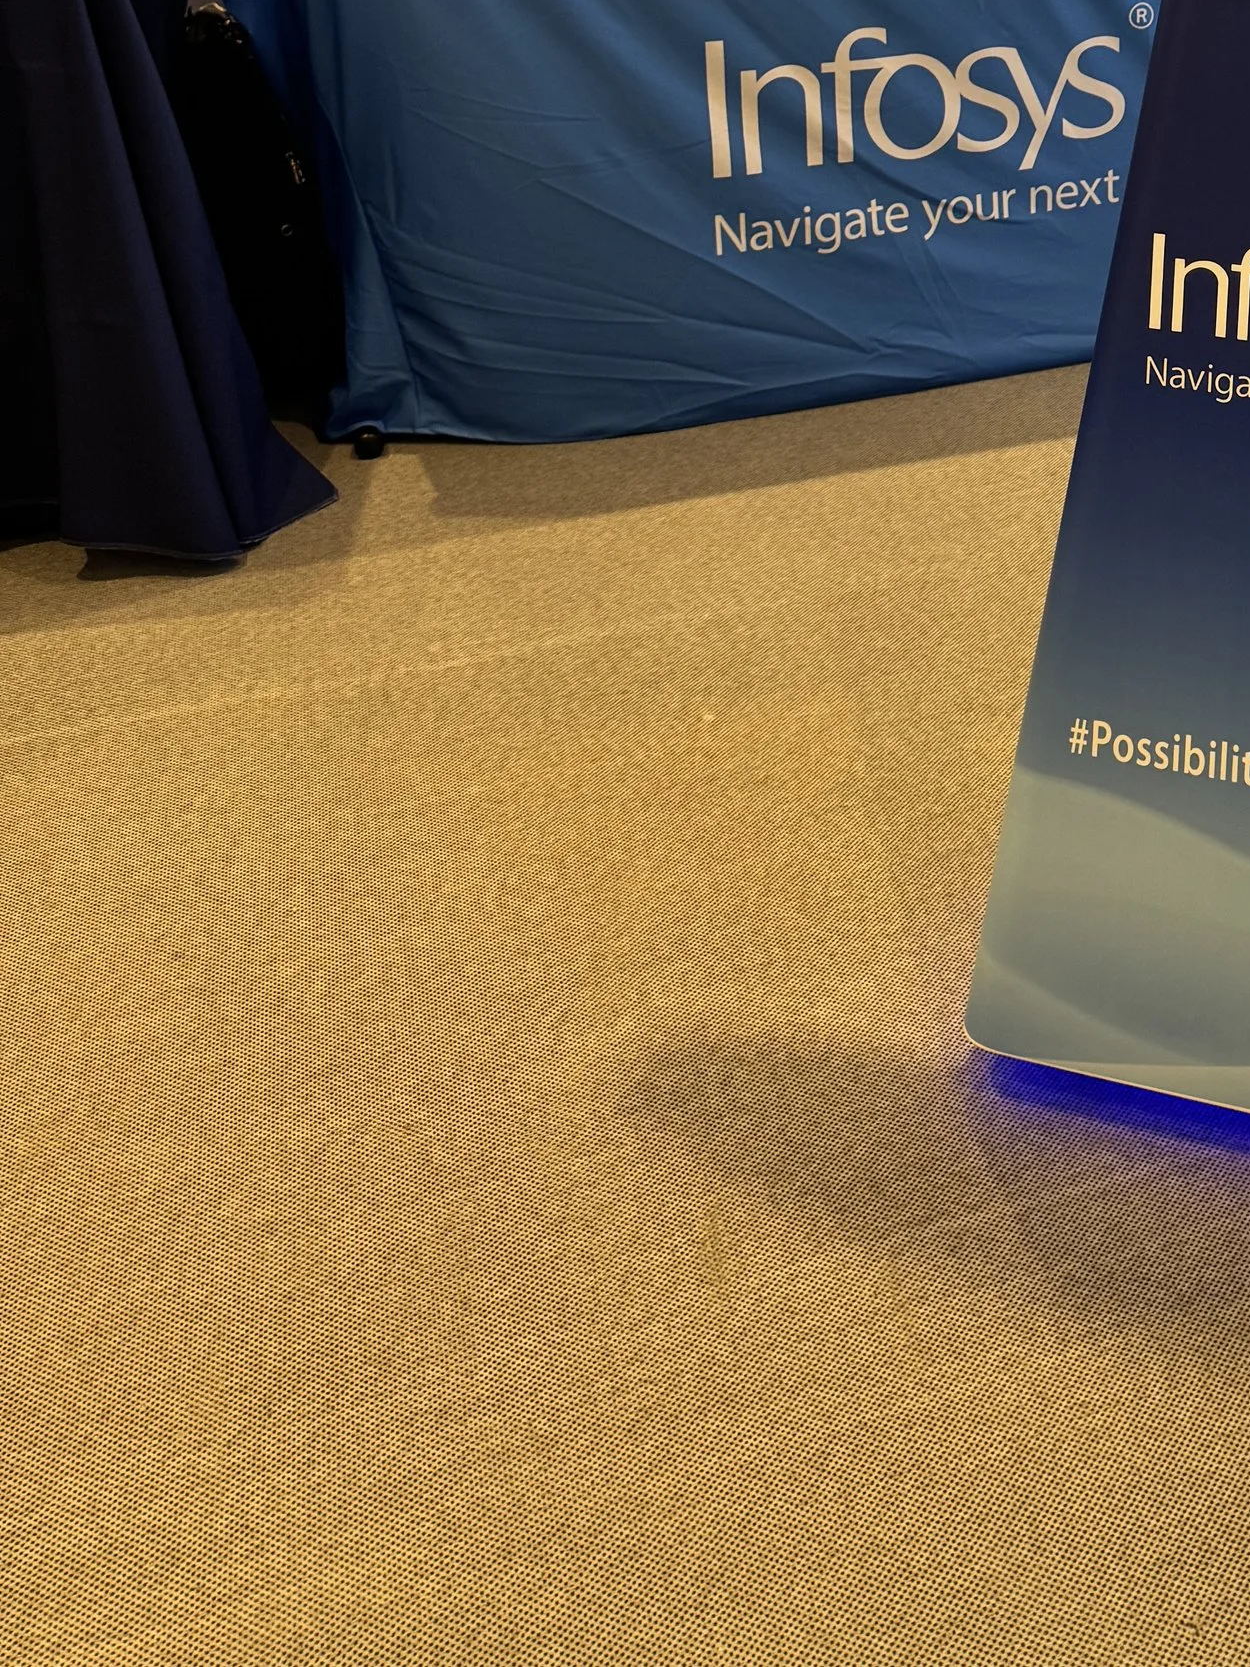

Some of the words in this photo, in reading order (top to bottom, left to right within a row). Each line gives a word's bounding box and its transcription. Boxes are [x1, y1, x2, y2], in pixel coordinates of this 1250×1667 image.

[713, 198, 909, 256] Navigate
[922, 187, 1017, 241] your
[1029, 169, 1121, 214] next
